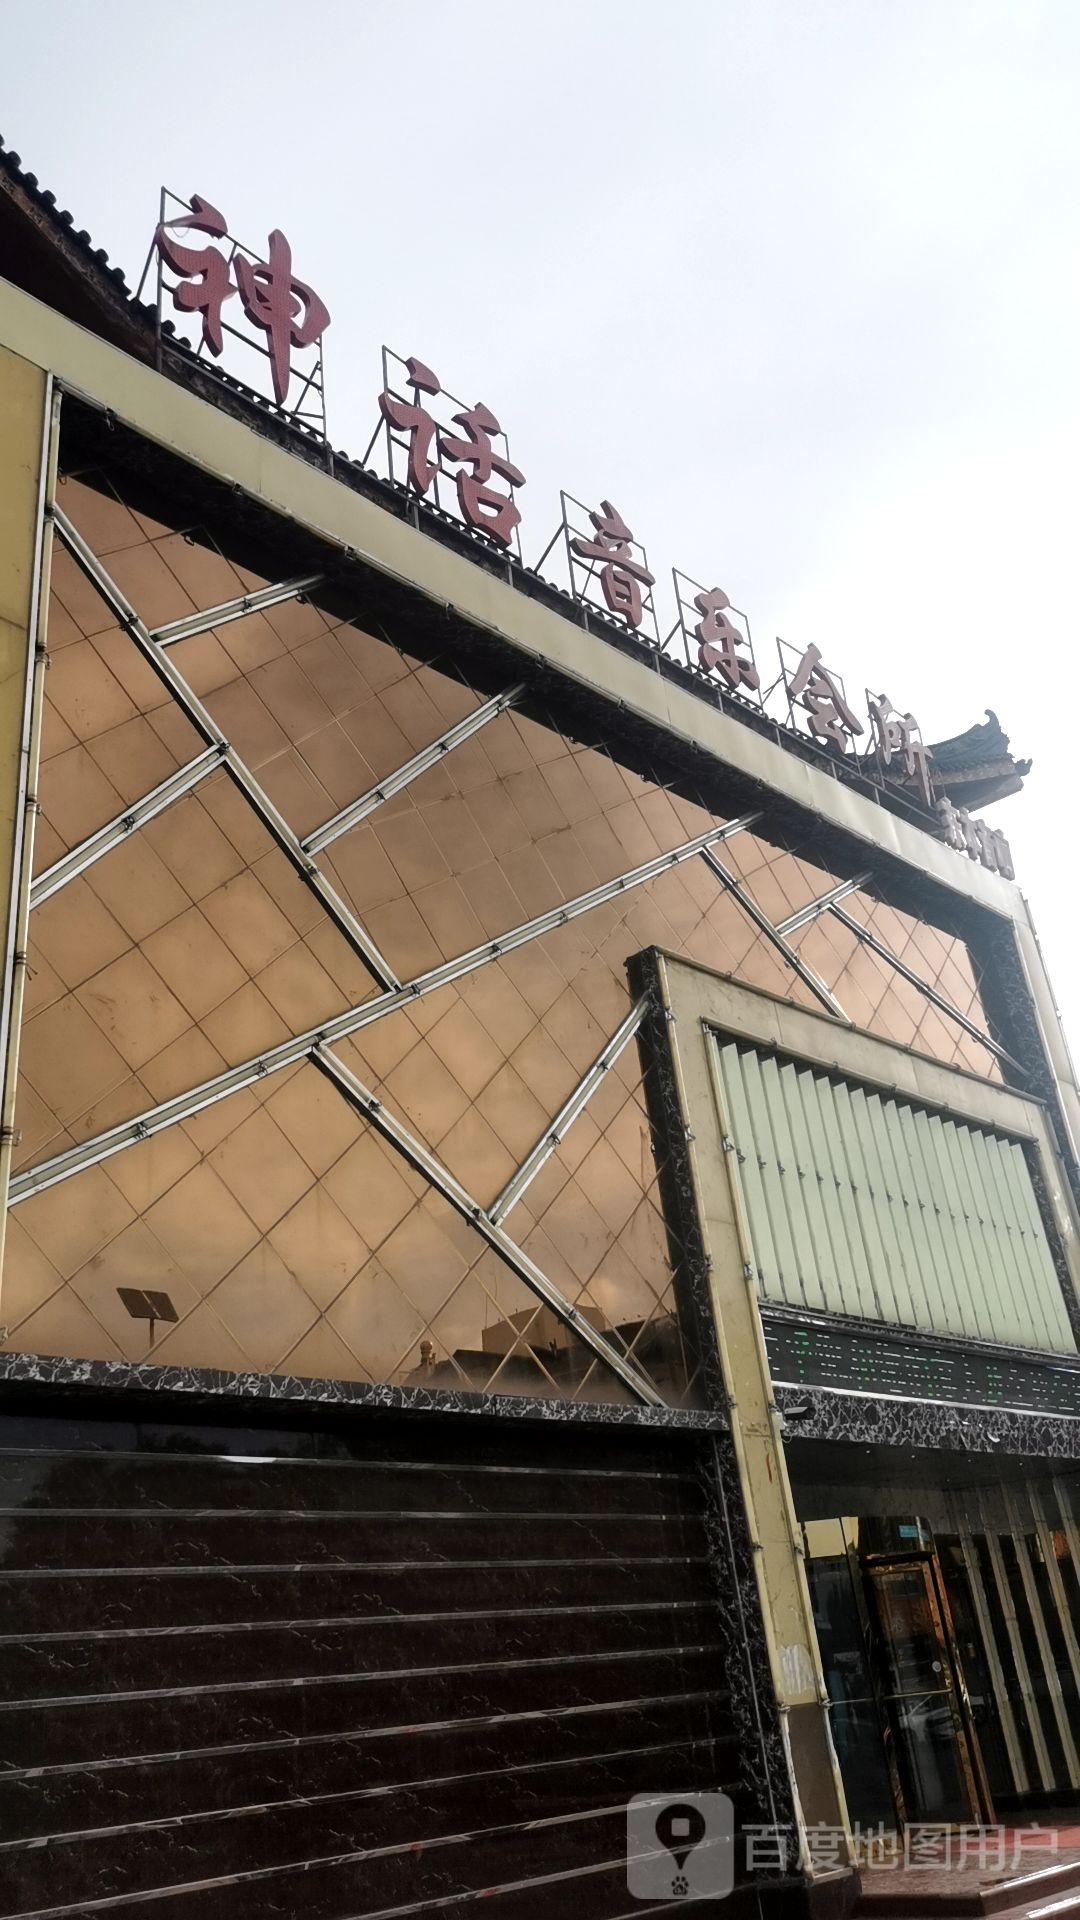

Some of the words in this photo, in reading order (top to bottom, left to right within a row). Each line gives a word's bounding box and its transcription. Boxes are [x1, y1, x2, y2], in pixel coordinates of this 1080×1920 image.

[156, 194, 932, 806] 神话音乐会所
